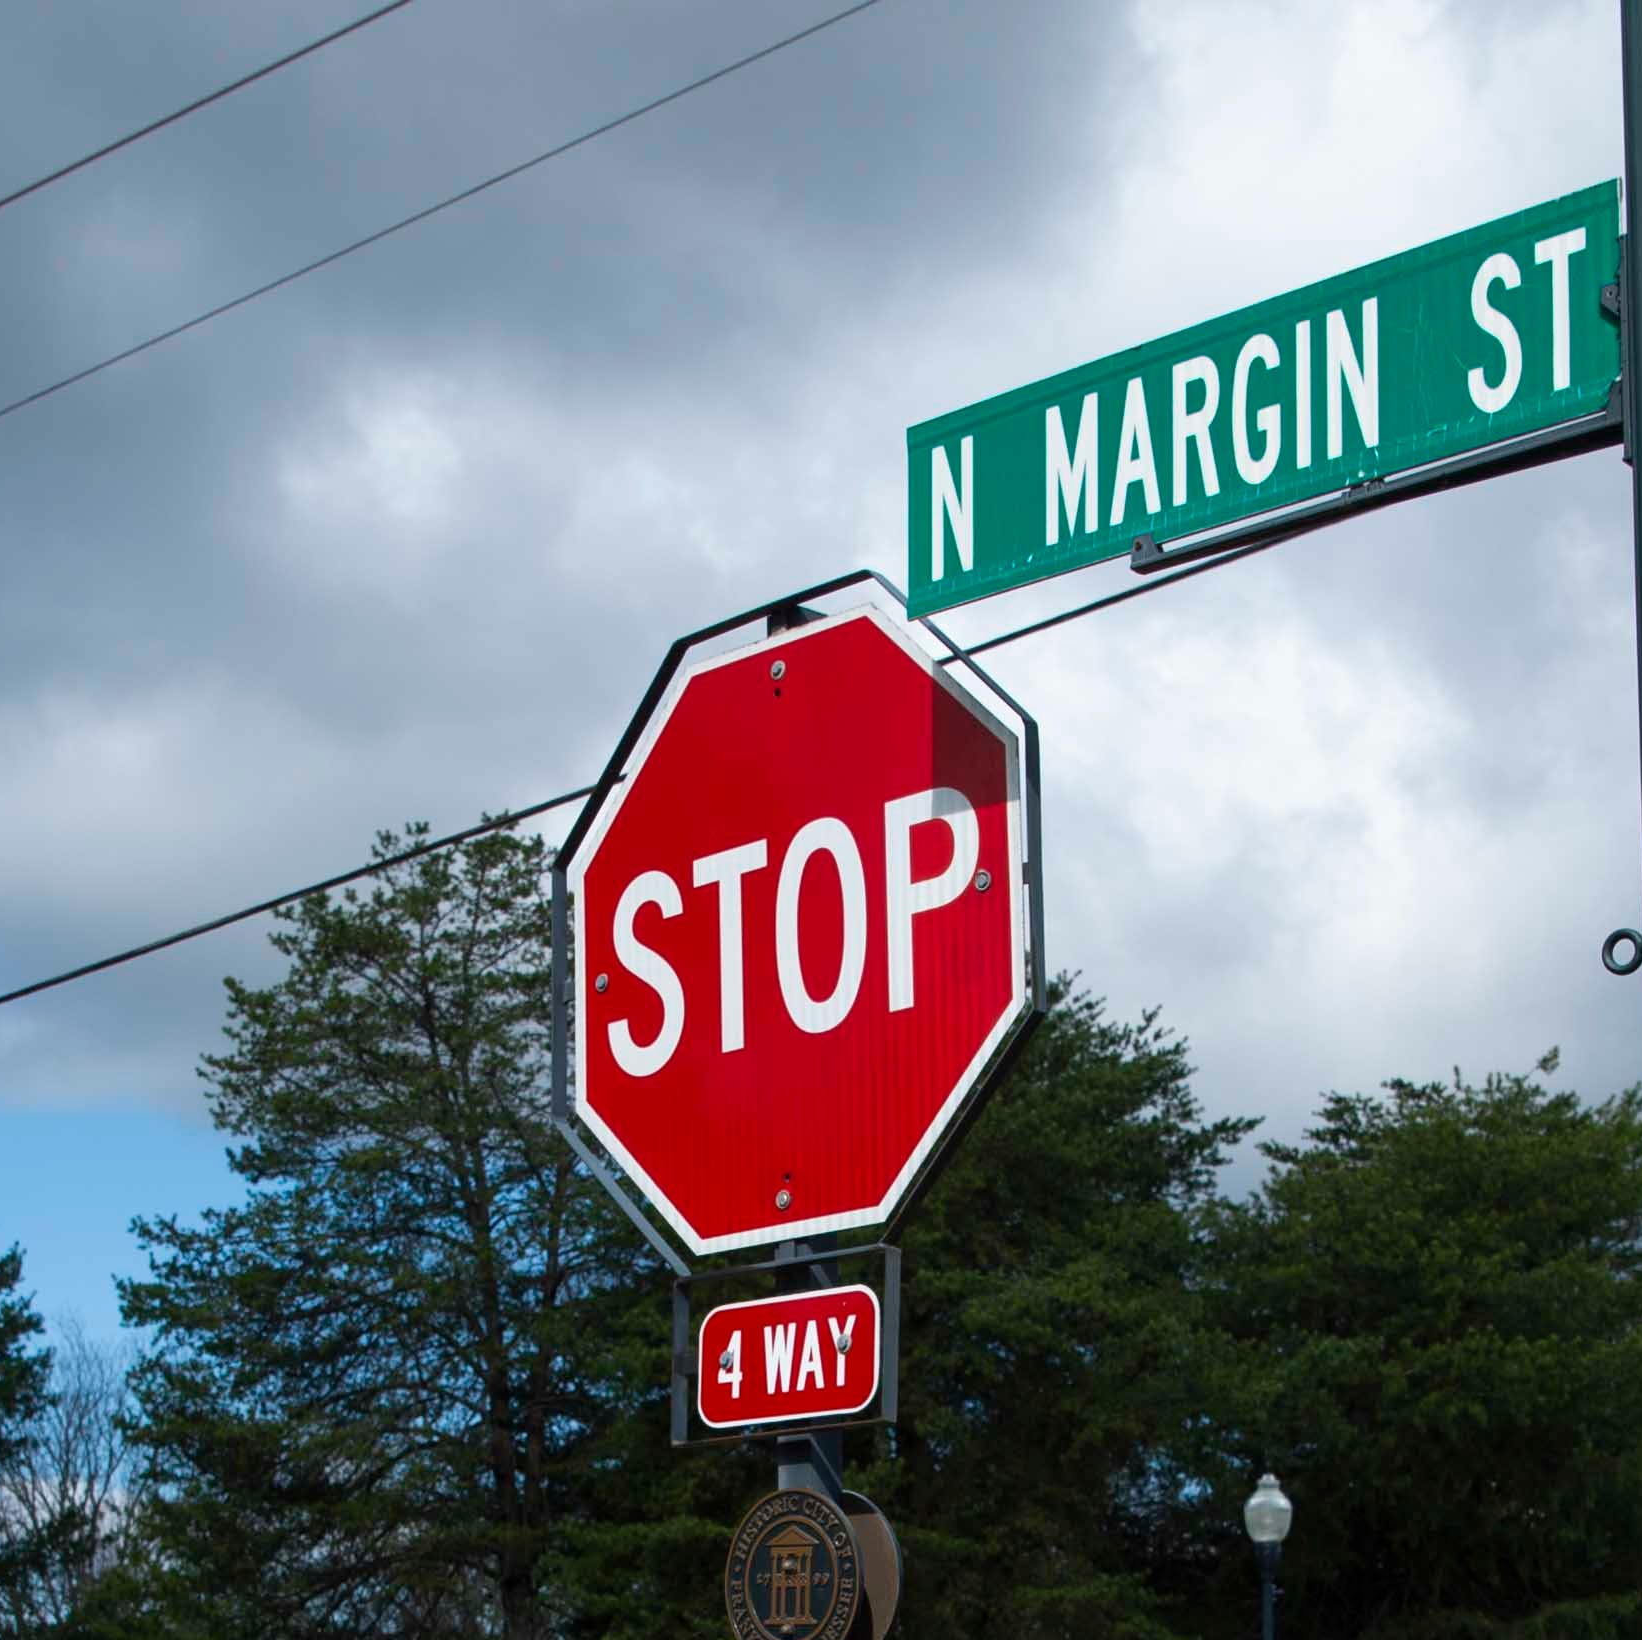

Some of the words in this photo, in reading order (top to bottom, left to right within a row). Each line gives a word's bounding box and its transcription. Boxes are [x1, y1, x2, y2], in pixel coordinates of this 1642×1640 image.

[931, 435, 974, 582] N
[1045, 297, 1379, 546] MARGIN
[1468, 227, 1586, 414] ST
[607, 787, 980, 1077] STOP
[717, 1330, 743, 1399] 4
[763, 1314, 857, 1395] WAY
[735, 1495, 799, 1560] HISTORIC
[802, 1499, 840, 1531] CITY
[833, 1531, 854, 1558] OF
